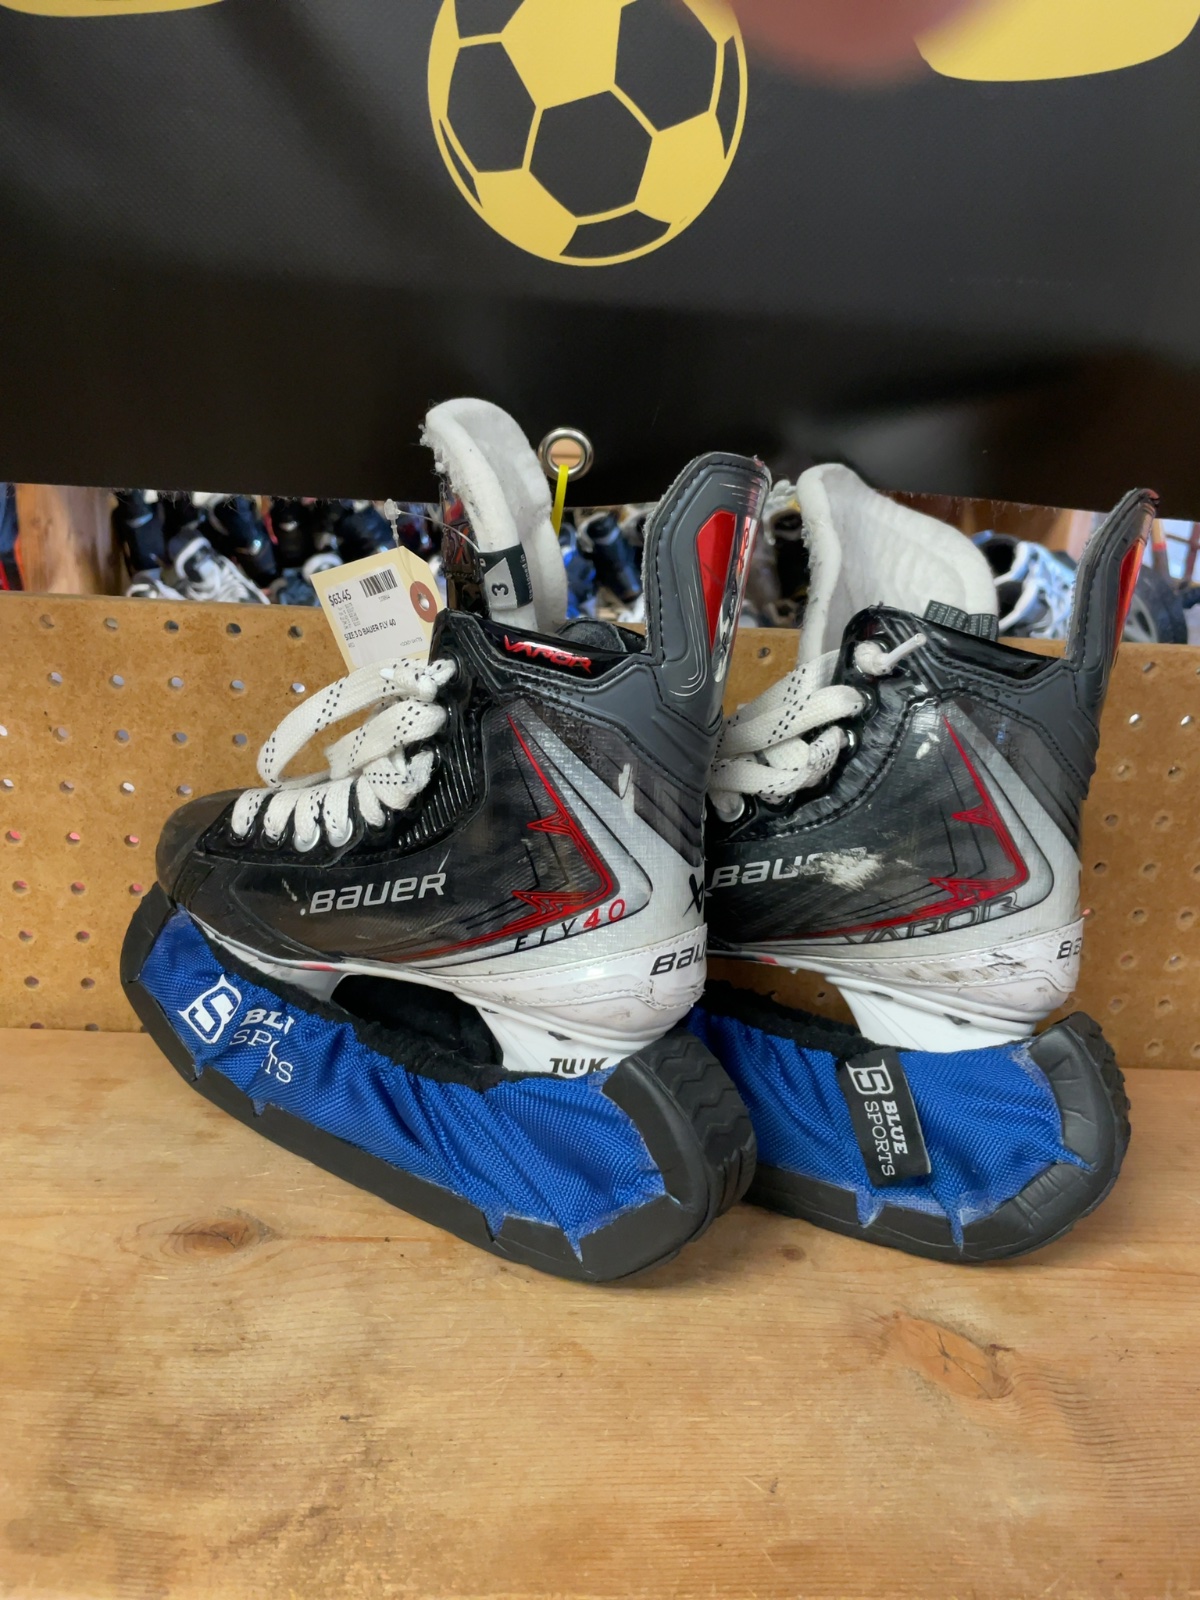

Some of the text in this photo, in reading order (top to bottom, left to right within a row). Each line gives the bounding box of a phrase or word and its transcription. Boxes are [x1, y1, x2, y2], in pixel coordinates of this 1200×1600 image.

[328, 589, 352, 607] $63.45
[491, 583, 509, 597] 3
[344, 631, 355, 641] SIZE
[362, 623, 380, 636] BAUER
[380, 620, 389, 630] FLY
[389, 618, 397, 627] 40
[309, 872, 446, 915] BAUER
[514, 898, 626, 952] FLY 40
[650, 941, 706, 976] BAU
[864, 1100, 896, 1176] SPORTS
[882, 1100, 908, 1154] BLUE
